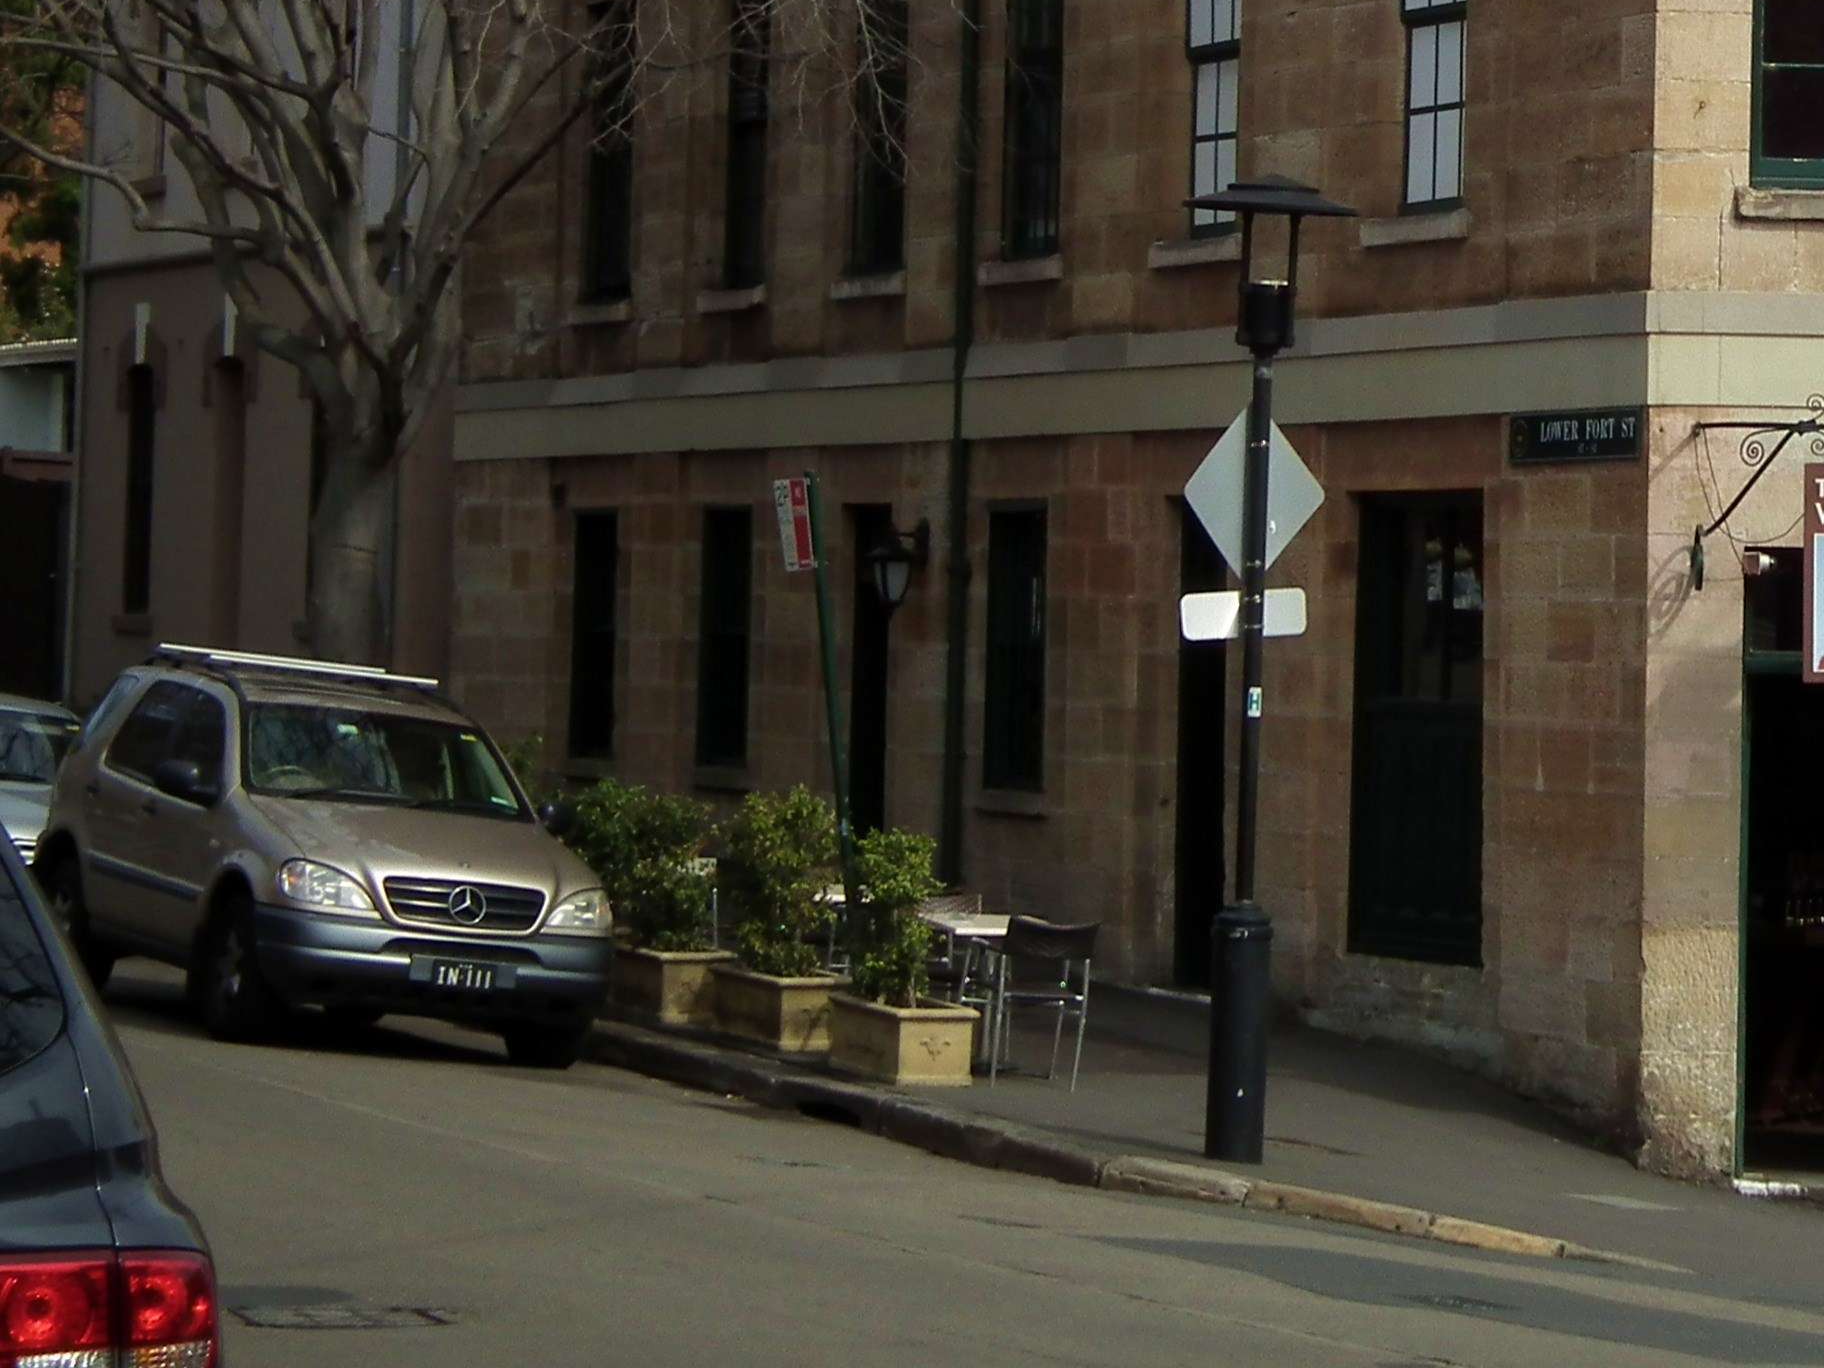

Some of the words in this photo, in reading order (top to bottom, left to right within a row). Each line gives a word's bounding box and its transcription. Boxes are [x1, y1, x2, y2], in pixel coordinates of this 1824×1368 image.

[1540, 419, 1579, 443] LOWER
[1585, 417, 1615, 440] FORT
[1621, 416, 1635, 438] ST
